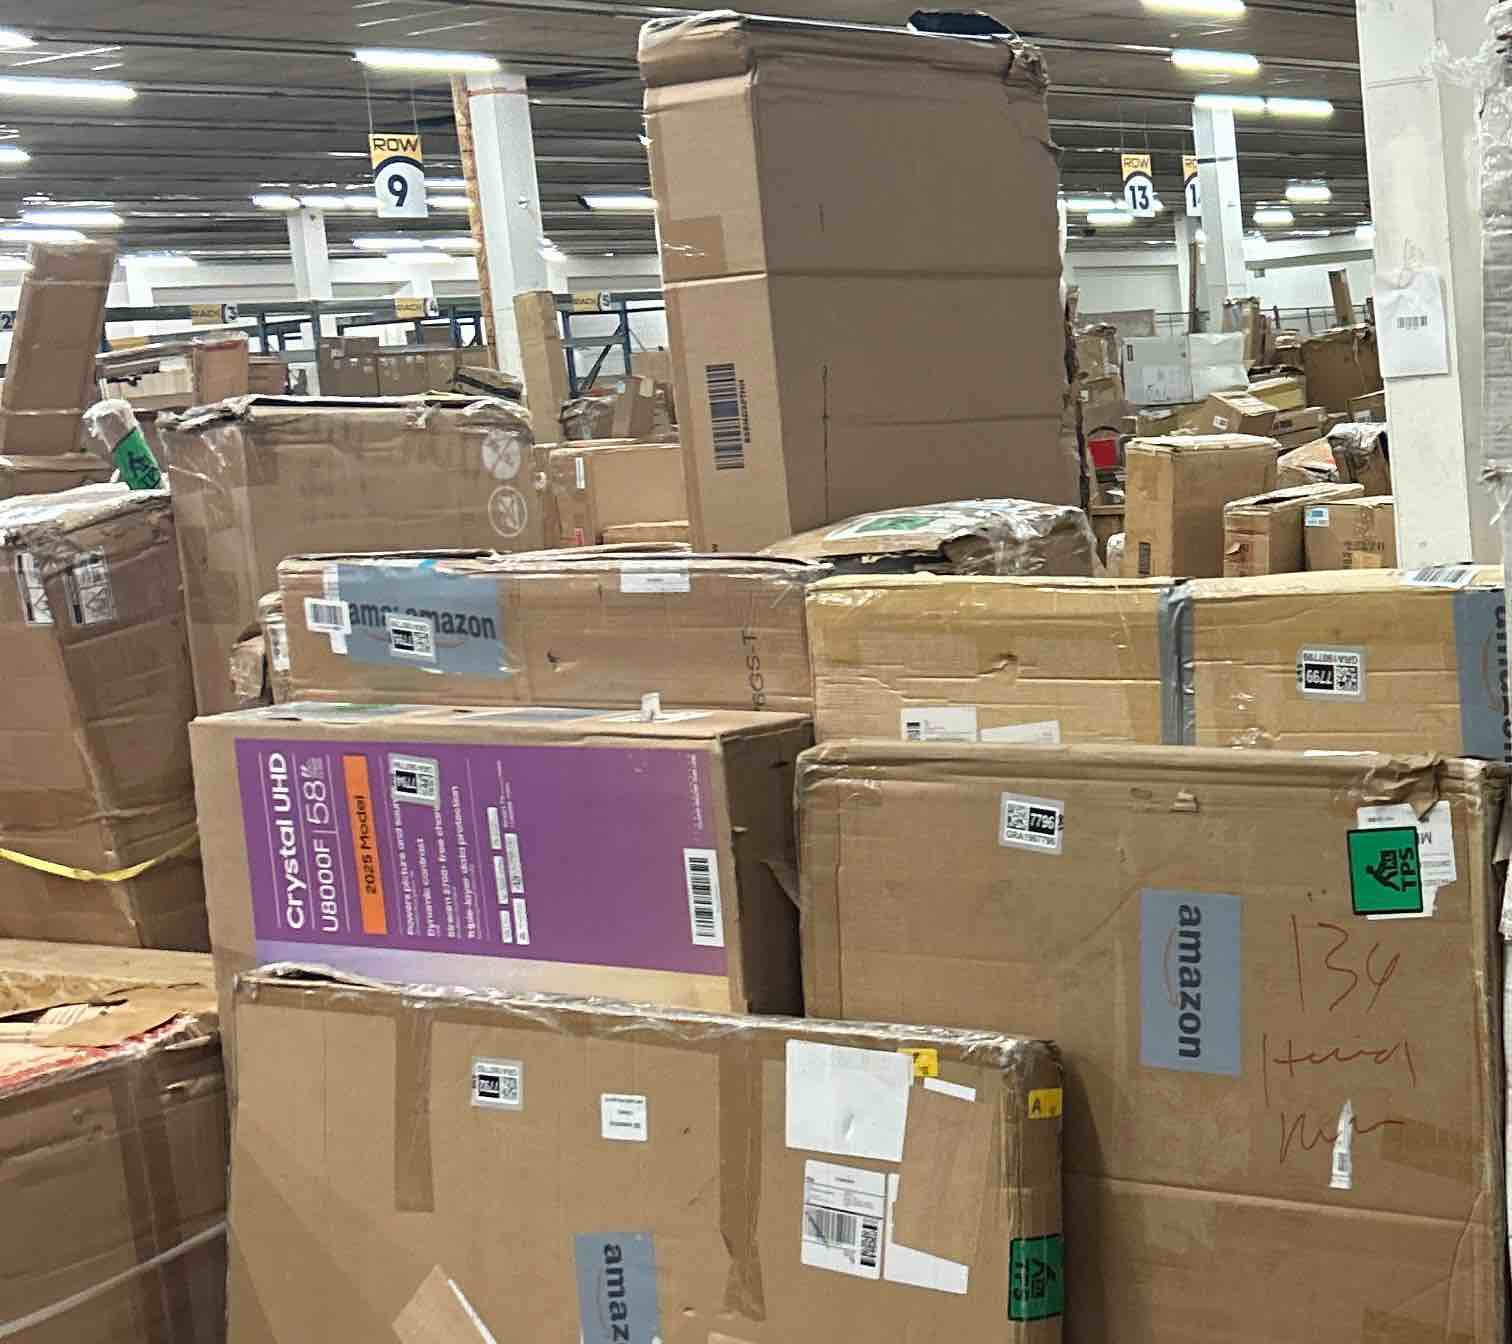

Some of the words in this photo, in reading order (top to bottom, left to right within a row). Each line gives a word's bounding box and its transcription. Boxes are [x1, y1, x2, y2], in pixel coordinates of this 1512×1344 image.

[372, 138, 418, 153] ROW
[387, 174, 408, 207] 9
[1129, 185, 1149, 210] 13
[1189, 184, 1200, 207] 1
[1305, 668, 1334, 685] 7799
[268, 752, 291, 813] UHD
[353, 795, 370, 850] Model
[275, 819, 307, 929] Crystal
[312, 839, 339, 933] U8000F
[361, 855, 376, 895] 2025
[1177, 903, 1202, 1059] amazon
